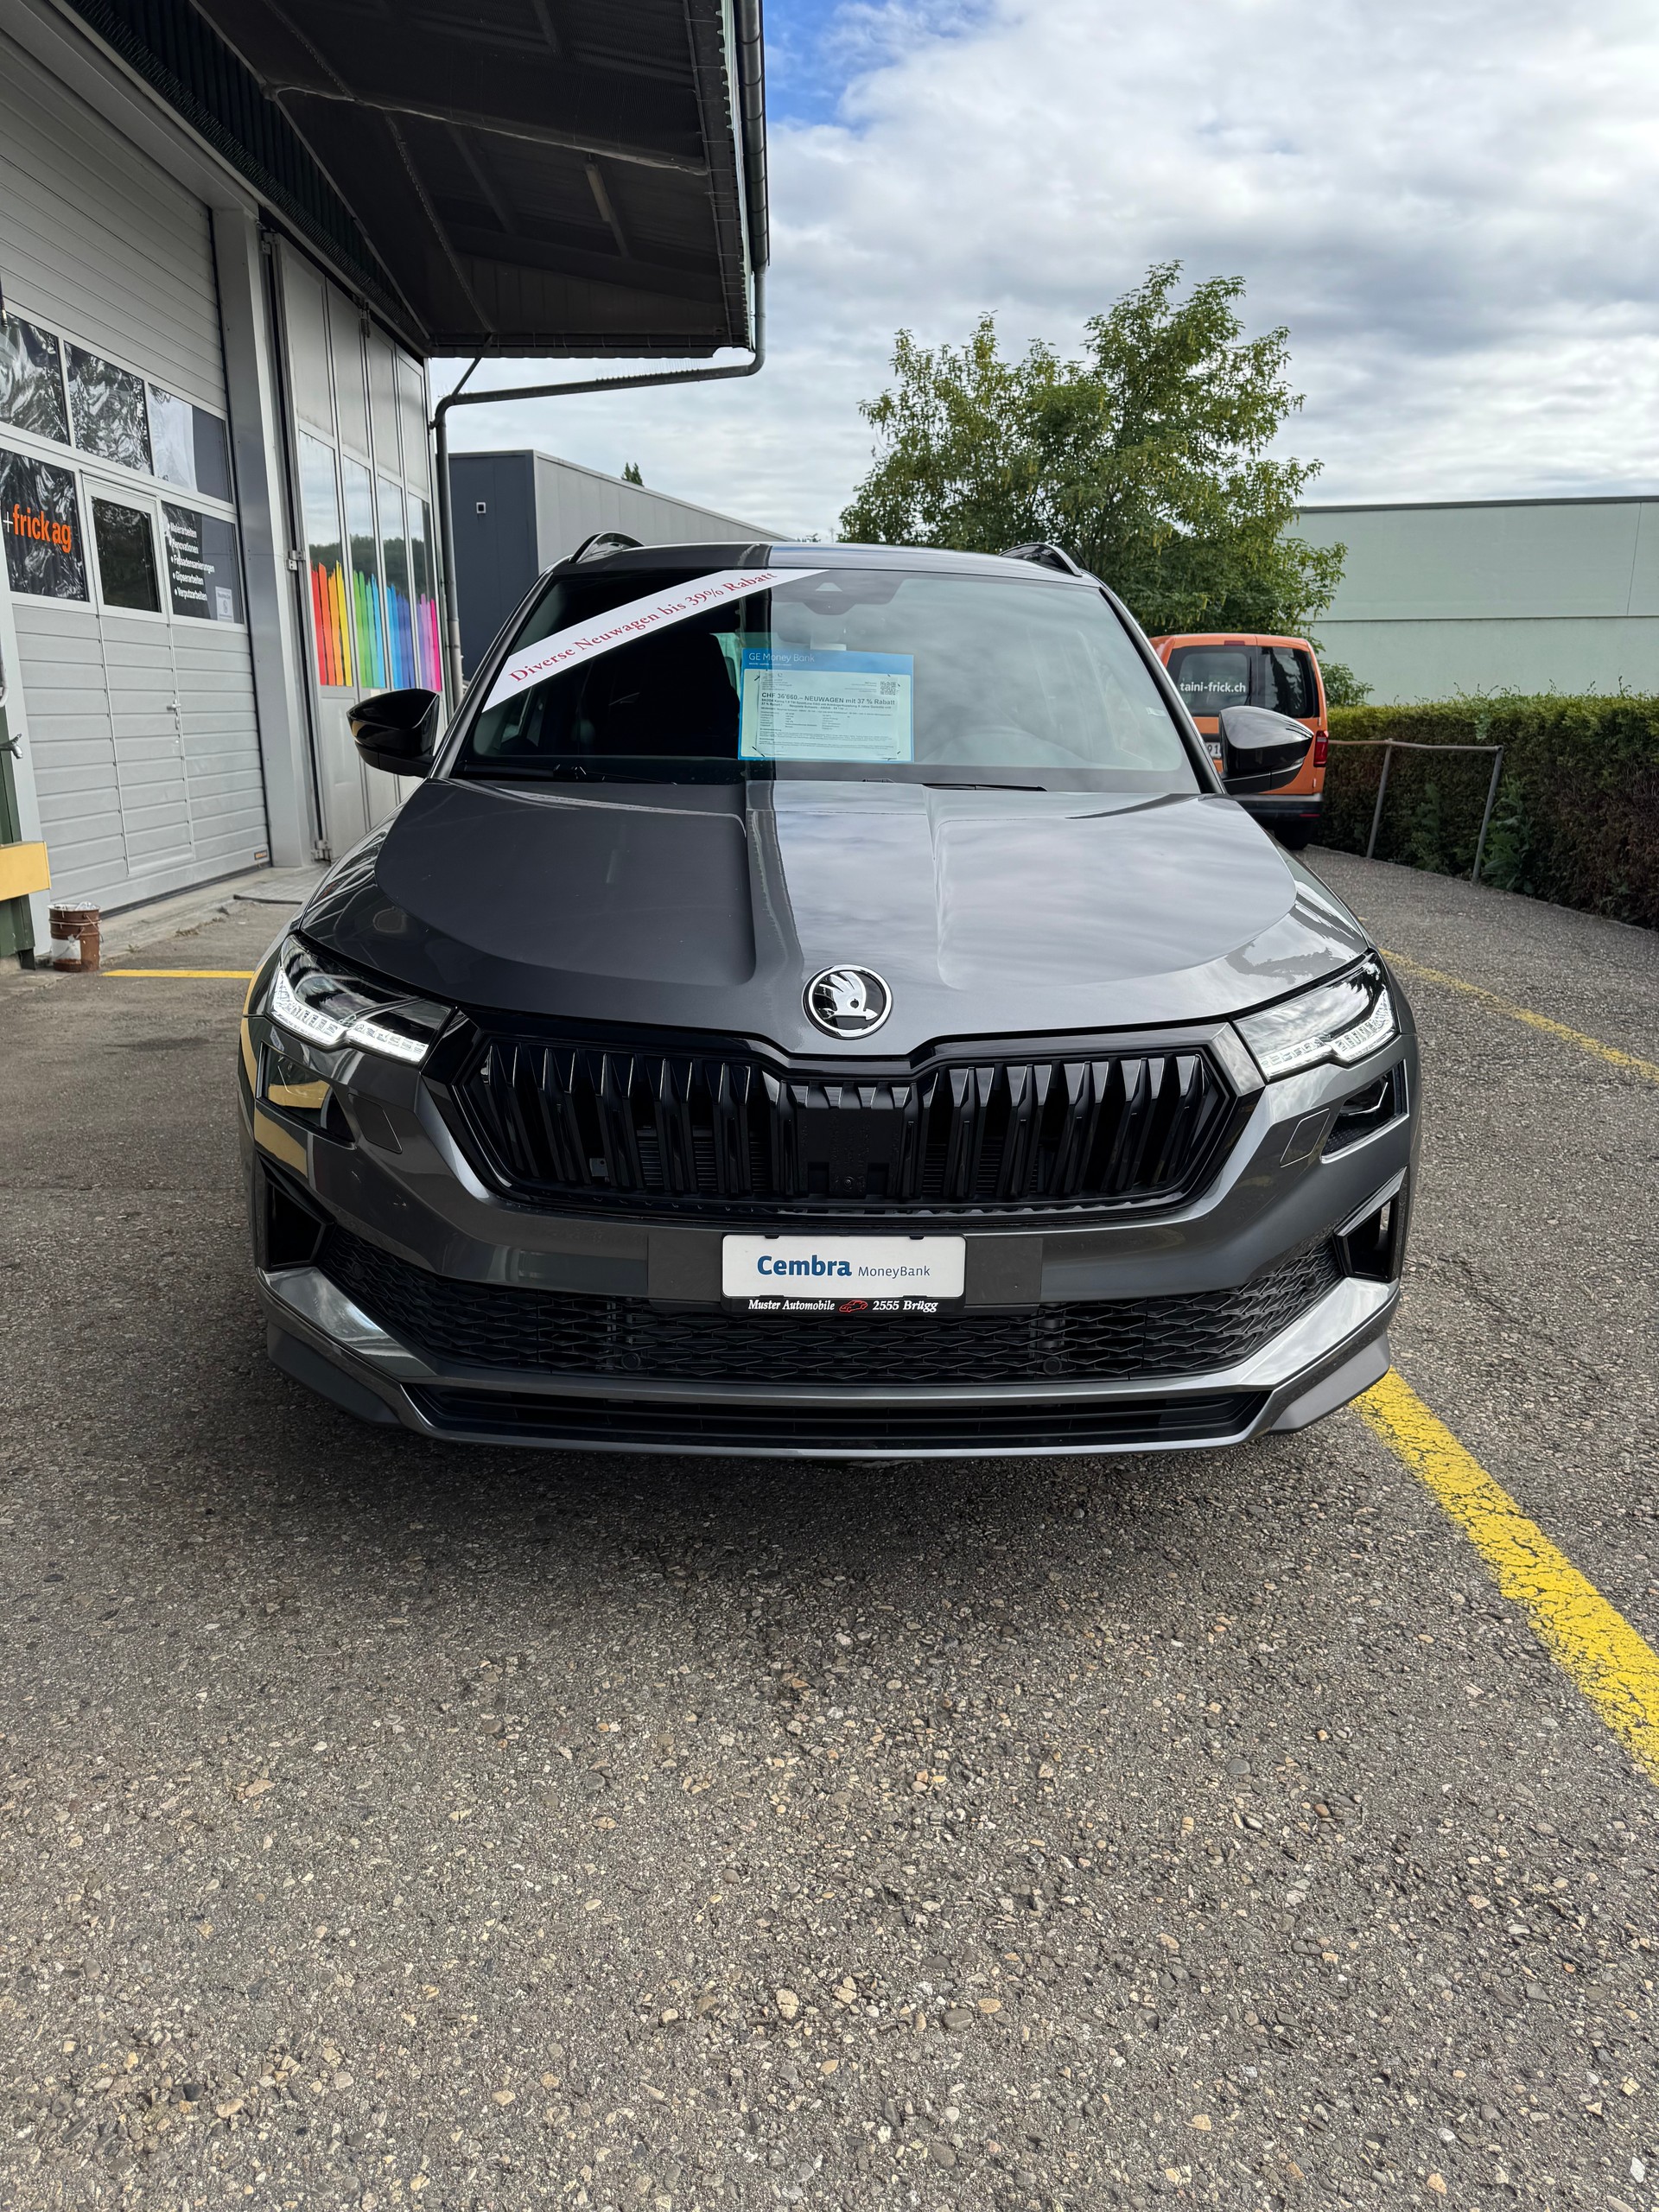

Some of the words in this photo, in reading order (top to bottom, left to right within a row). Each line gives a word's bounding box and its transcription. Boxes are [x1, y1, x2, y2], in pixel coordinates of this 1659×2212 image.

[52, 522, 72, 553] ag
[508, 648, 575, 682] Diverse
[572, 613, 661, 651] Neuwagen
[657, 602, 687, 616] bis
[685, 588, 725, 607] 39%
[721, 572, 778, 592] Rabatt
[748, 652, 761, 661] GE
[763, 653, 791, 663] Money
[793, 653, 815, 663] Bank
[1179, 681, 1246, 693] taini-frick.ch
[804, 695, 844, 703] NEUWAGEN
[757, 1255, 852, 1276] Cembra
[858, 1265, 931, 1279] MoneyBank
[748, 1300, 780, 1311] Muster
[782, 1300, 836, 1311] Automobile
[873, 1300, 899, 1311] 2555
[903, 1300, 938, 1313] Brügg
